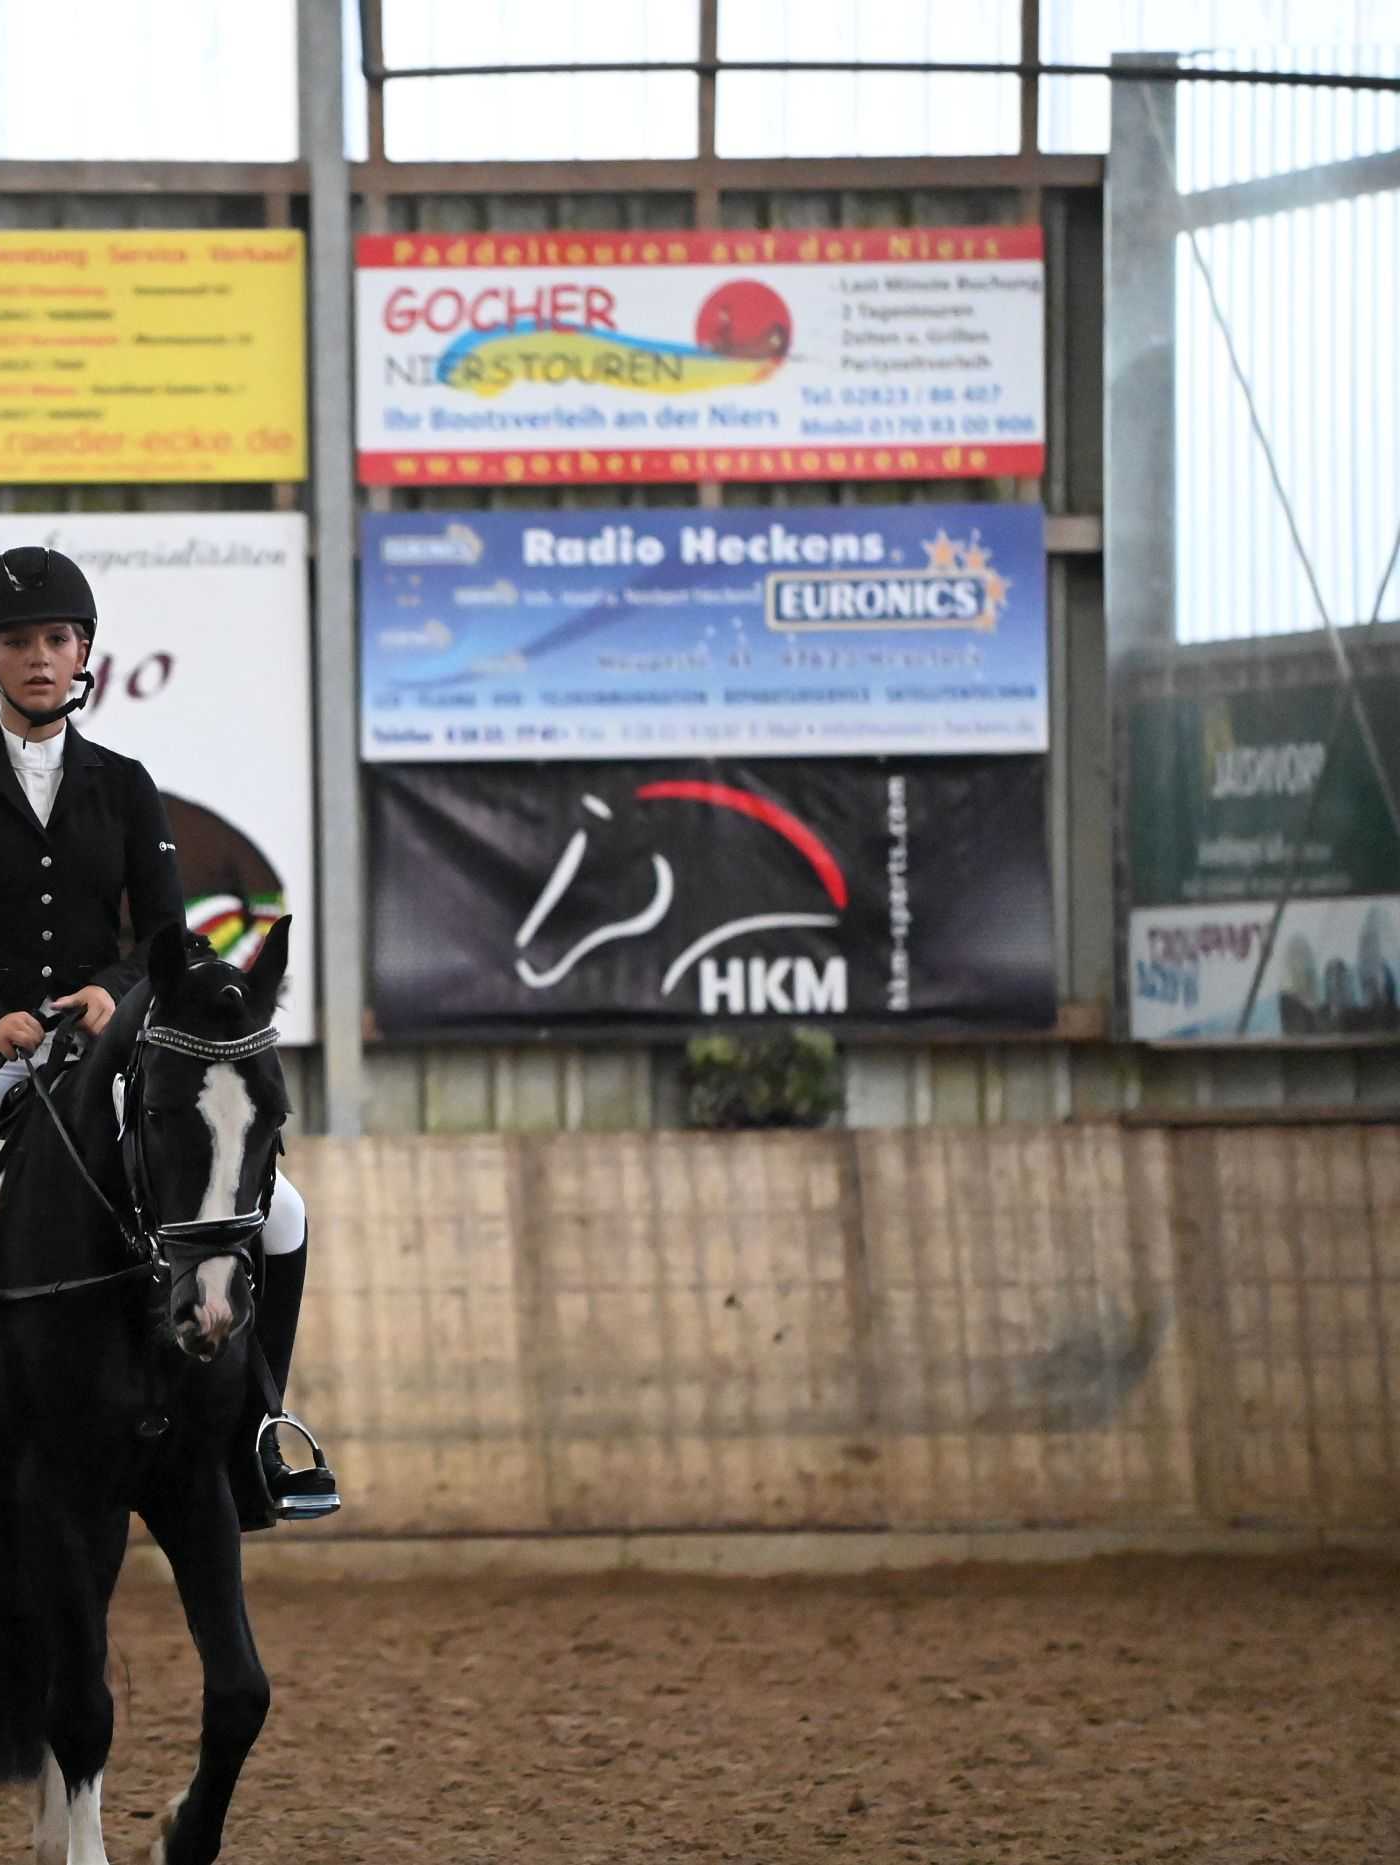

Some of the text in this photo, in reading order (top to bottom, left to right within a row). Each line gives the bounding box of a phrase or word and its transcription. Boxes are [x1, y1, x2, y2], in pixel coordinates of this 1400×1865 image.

[393, 233, 1001, 265] Paddeltouren auf der Niers
[383, 283, 618, 335] GOCHER
[385, 351, 685, 387] NIERSTOUREN
[431, 405, 606, 431] Bootsverleih
[613, 410, 649, 429] an
[656, 404, 699, 428] der
[708, 404, 781, 429] Niers
[392, 446, 990, 483] www.gocher-nierstouren.de
[522, 524, 665, 568] Radio
[778, 580, 979, 620] EURONICS
[700, 956, 849, 1015] HKM
